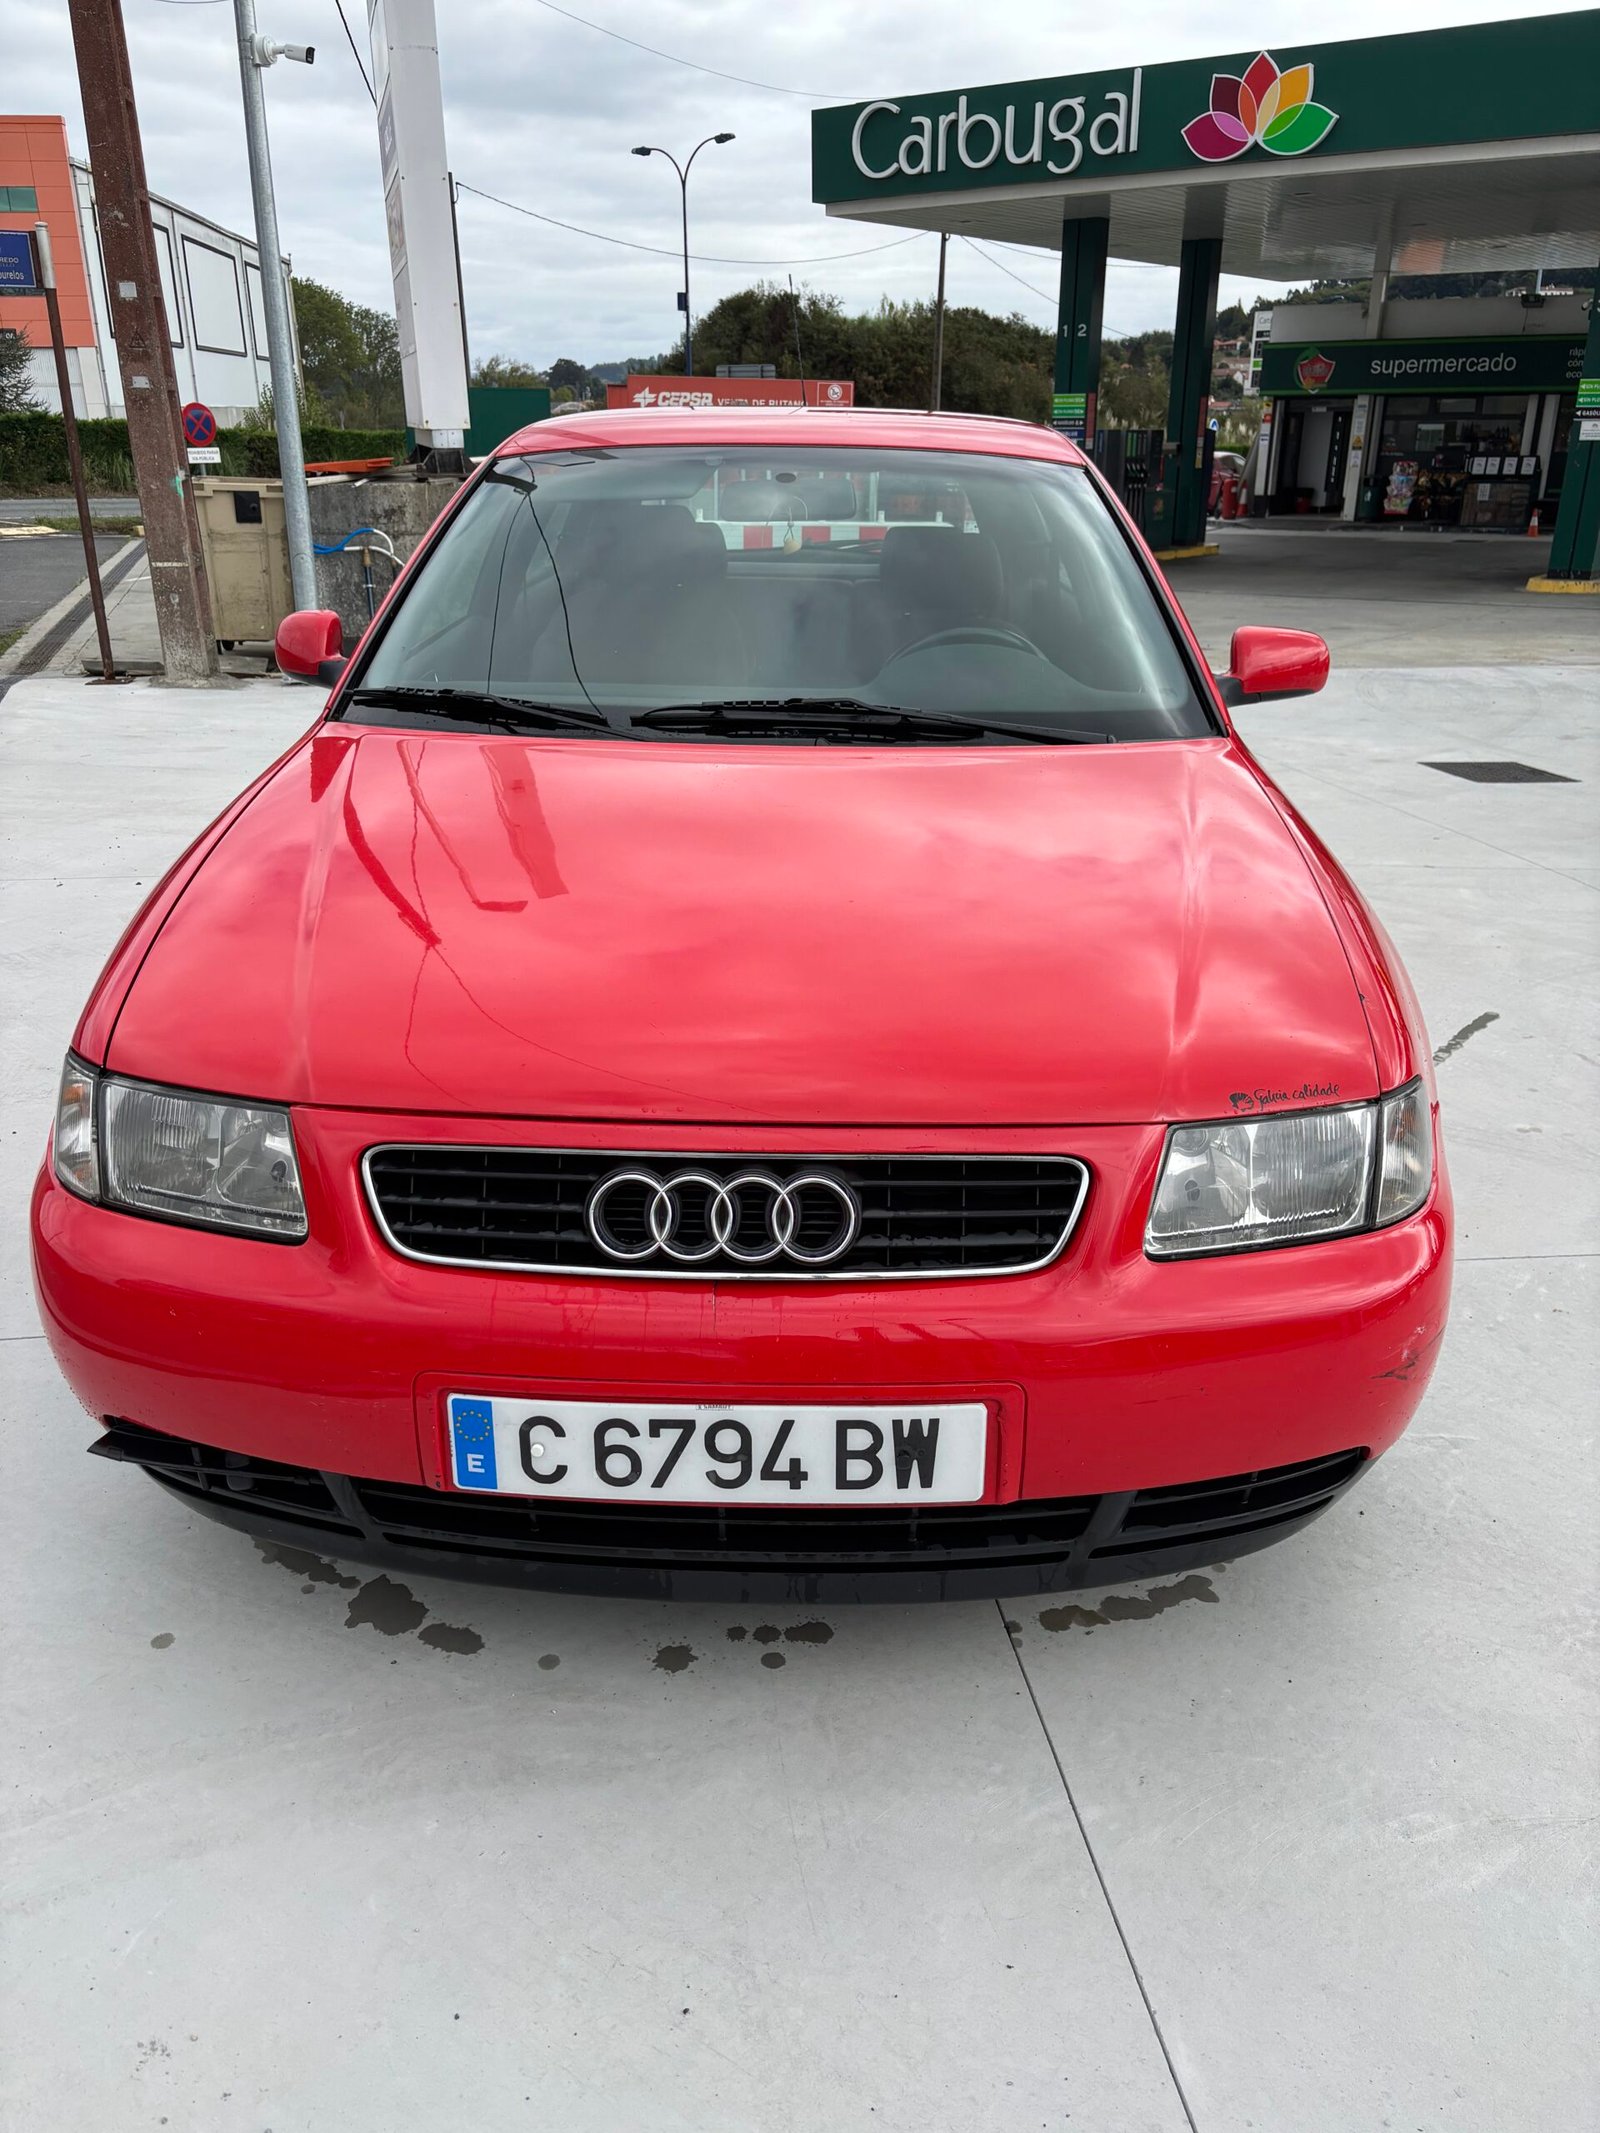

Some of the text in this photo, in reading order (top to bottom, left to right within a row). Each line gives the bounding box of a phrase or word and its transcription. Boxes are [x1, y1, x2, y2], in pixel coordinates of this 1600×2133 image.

[851, 67, 1143, 179] Carbugal
[1062, 323, 1087, 338] 1 2
[1370, 352, 1517, 379] supermercado
[657, 391, 714, 406] CEPSA
[1292, 1082, 1340, 1100] calidade
[518, 1415, 940, 1490] C 6794 BW
[466, 1453, 486, 1474] E
